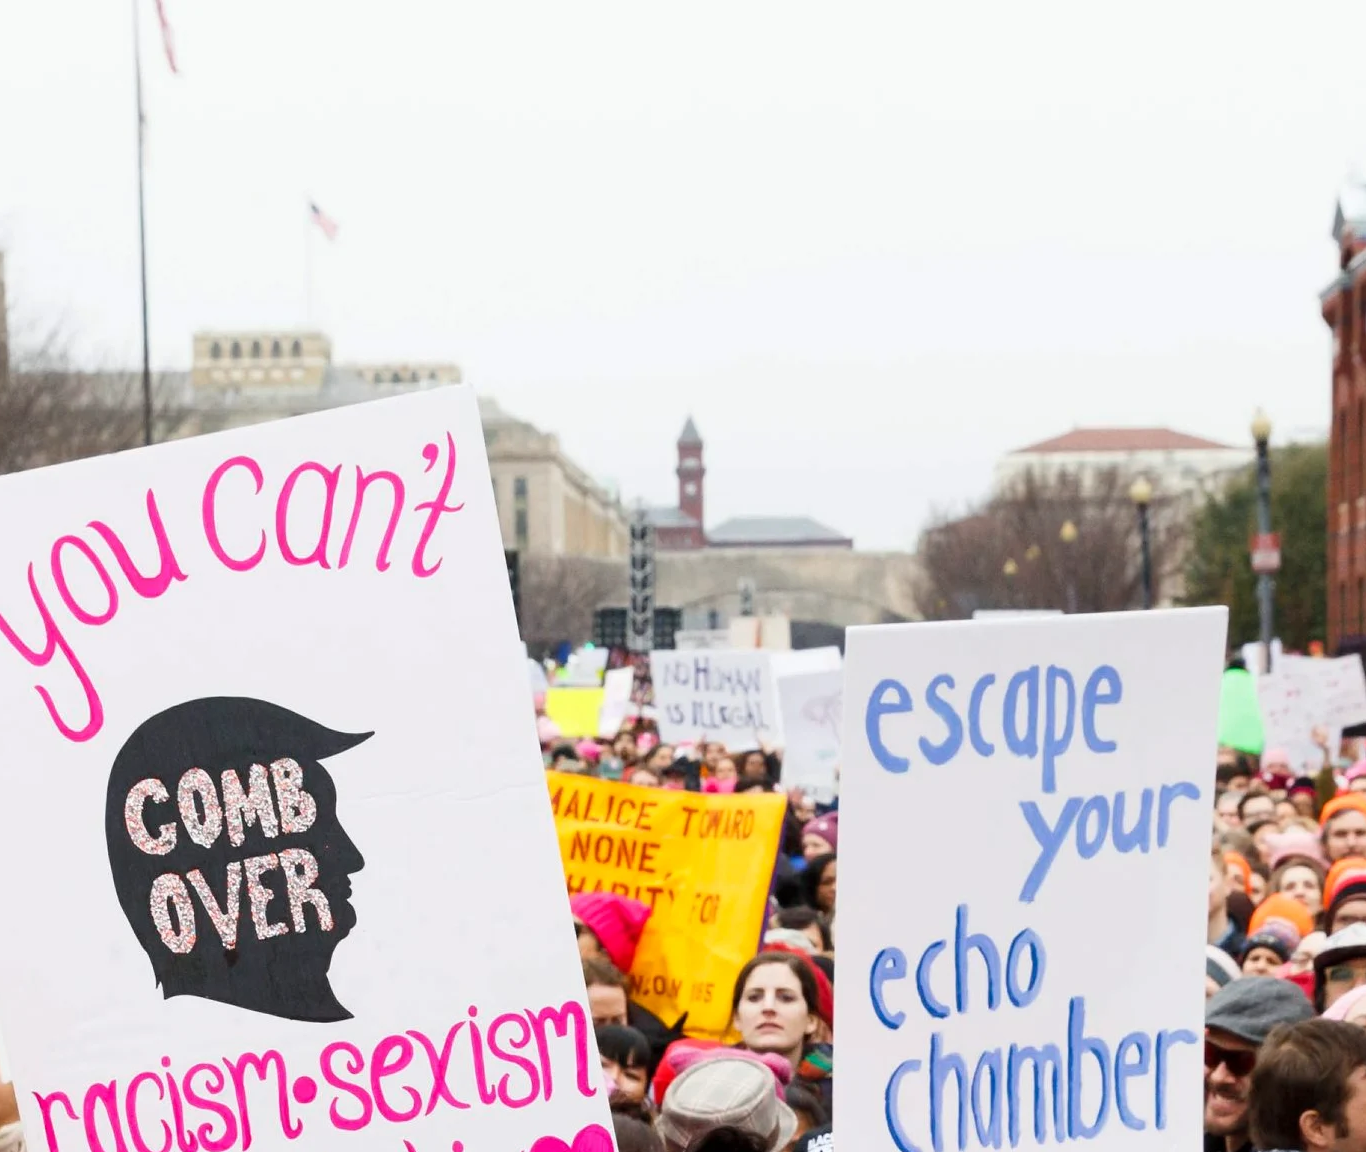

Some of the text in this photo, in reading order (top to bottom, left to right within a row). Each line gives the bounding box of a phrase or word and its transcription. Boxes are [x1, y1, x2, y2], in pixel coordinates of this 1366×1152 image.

[202, 431, 464, 579] can't
[866, 665, 1123, 793] escape
[124, 756, 317, 856] COMB
[570, 830, 672, 881] NONE,
[682, 806, 755, 841] TOWARD
[1019, 781, 1201, 903] your
[149, 847, 334, 955] OVER
[869, 903, 1047, 1031] echo
